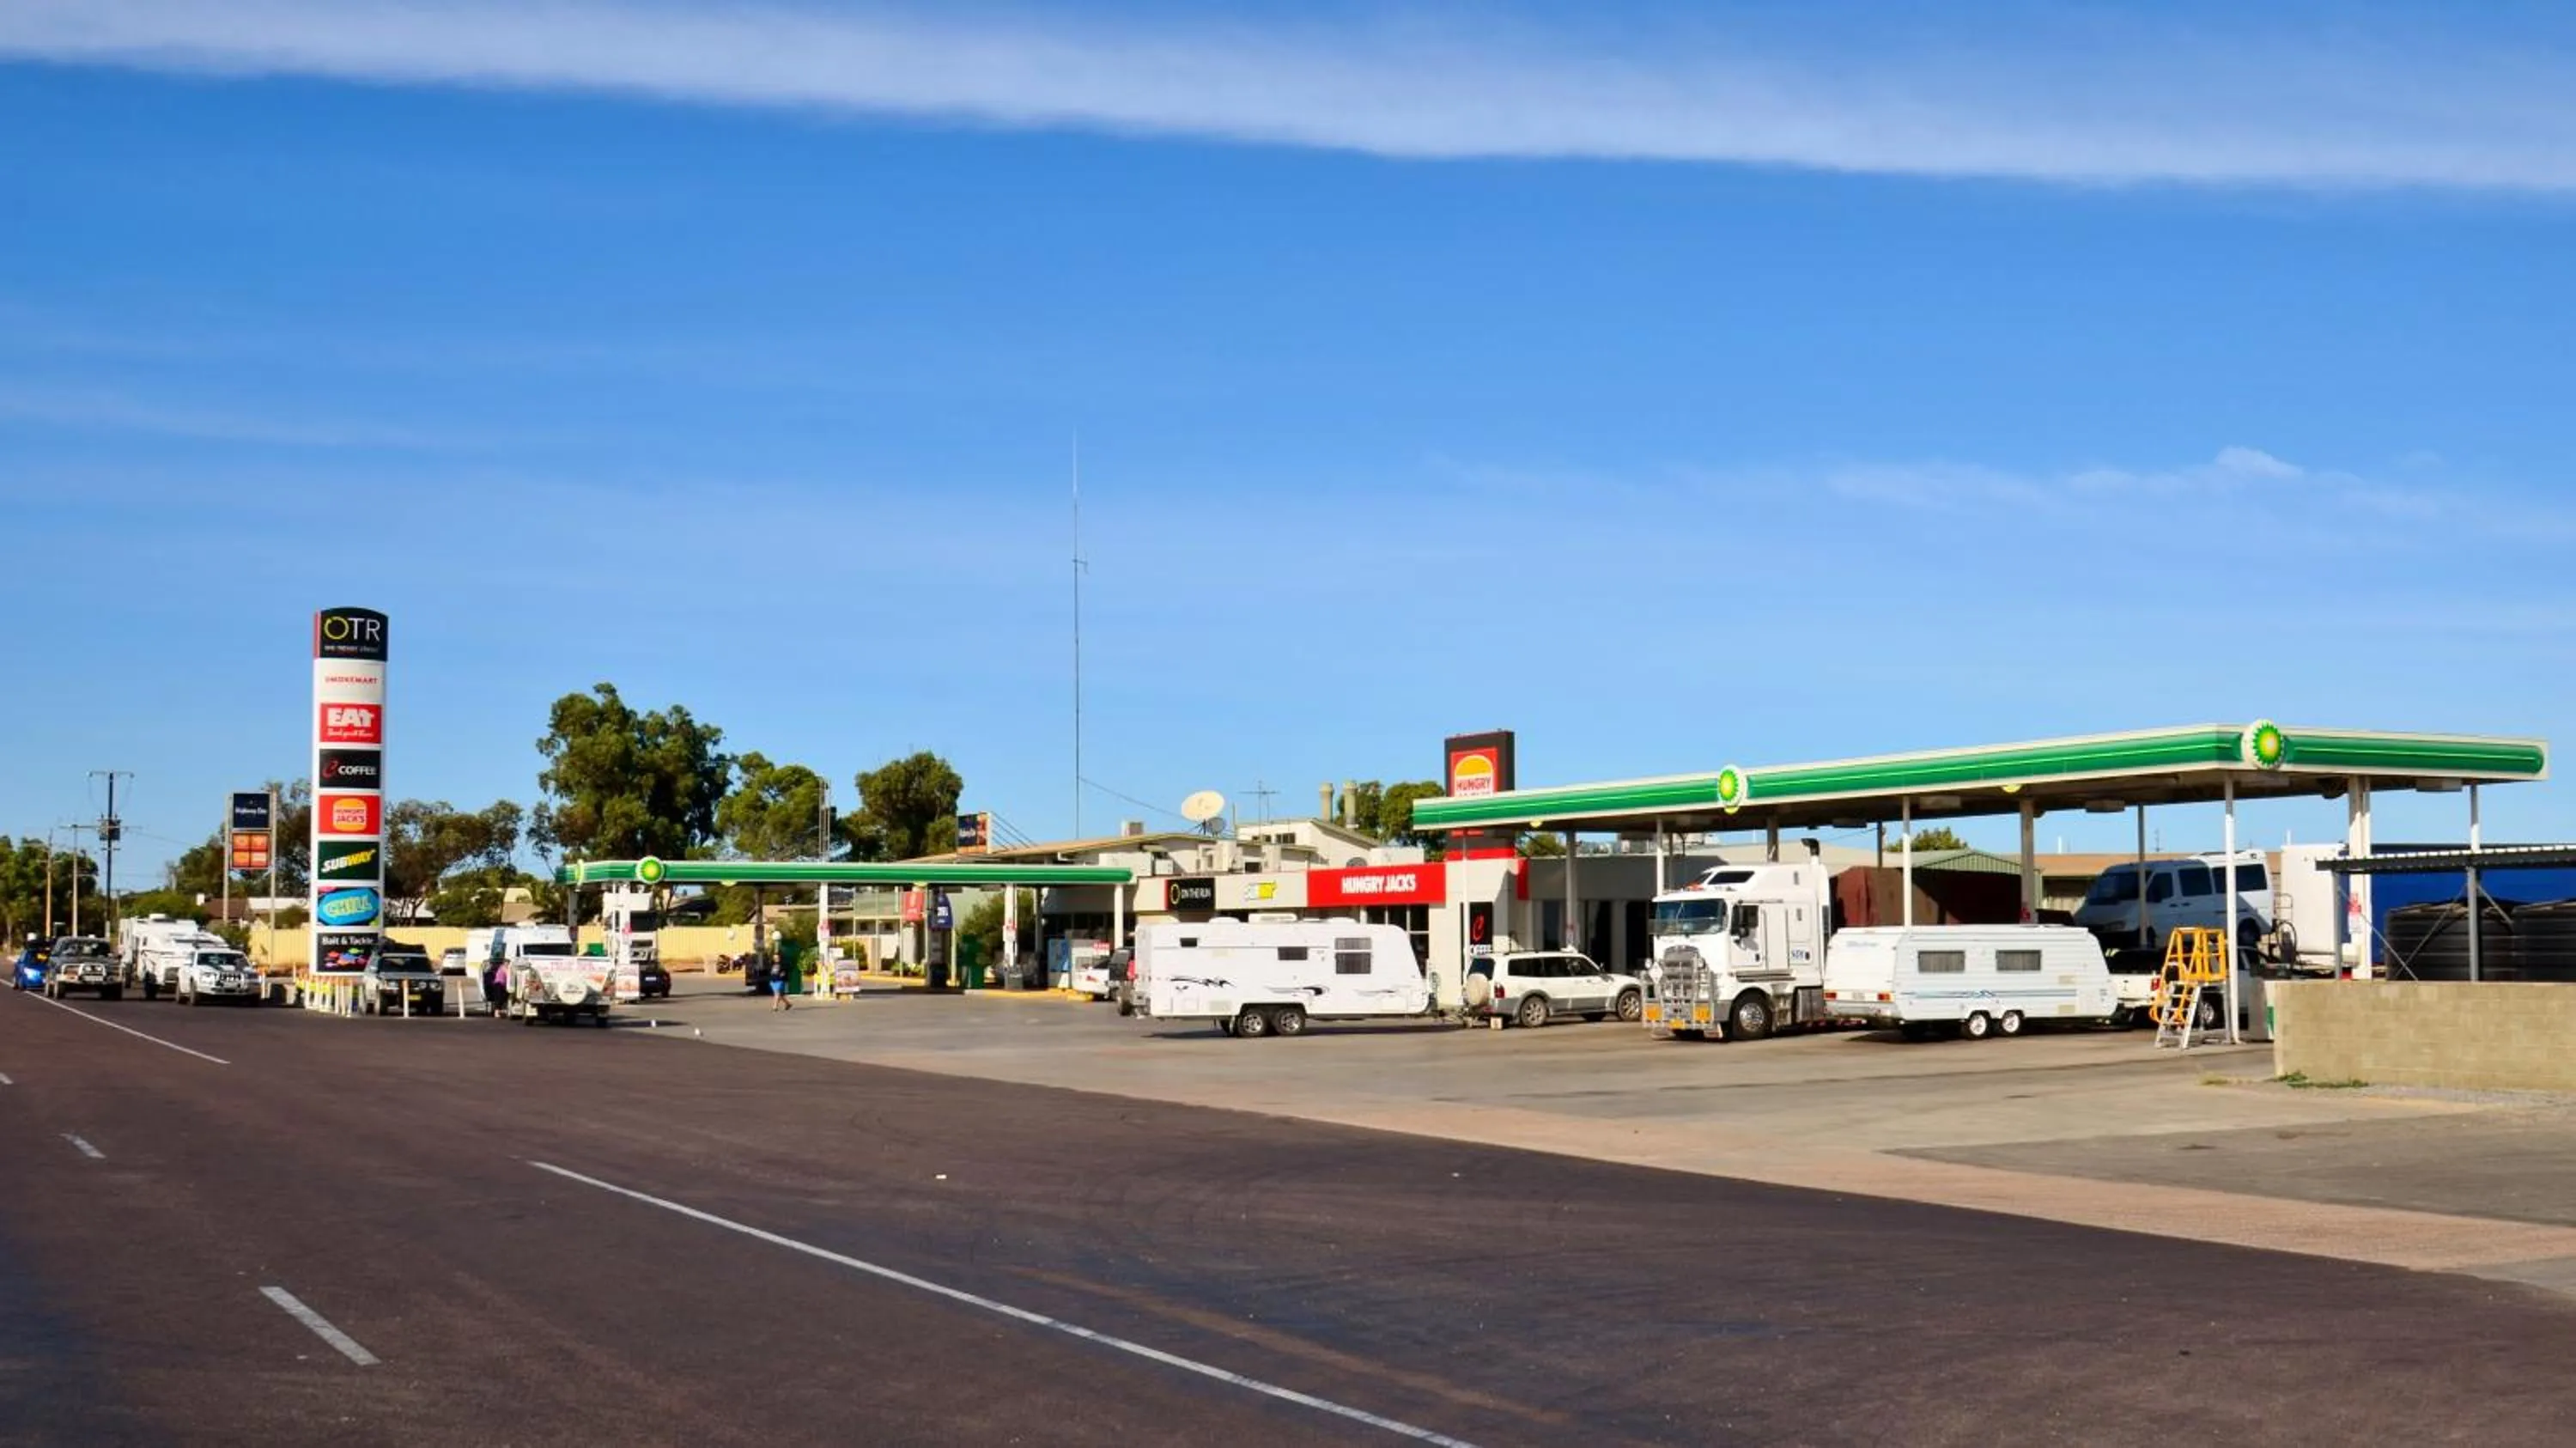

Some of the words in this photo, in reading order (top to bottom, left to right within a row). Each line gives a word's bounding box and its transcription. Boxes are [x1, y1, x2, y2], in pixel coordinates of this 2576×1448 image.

[324, 616, 381, 642] OTR
[327, 707, 375, 727] EAT
[338, 765, 376, 776] COFFEE
[1455, 776, 1491, 790] HUNGRY
[321, 849, 376, 873] SUBWAY
[1342, 876, 1383, 893] HUNGRY
